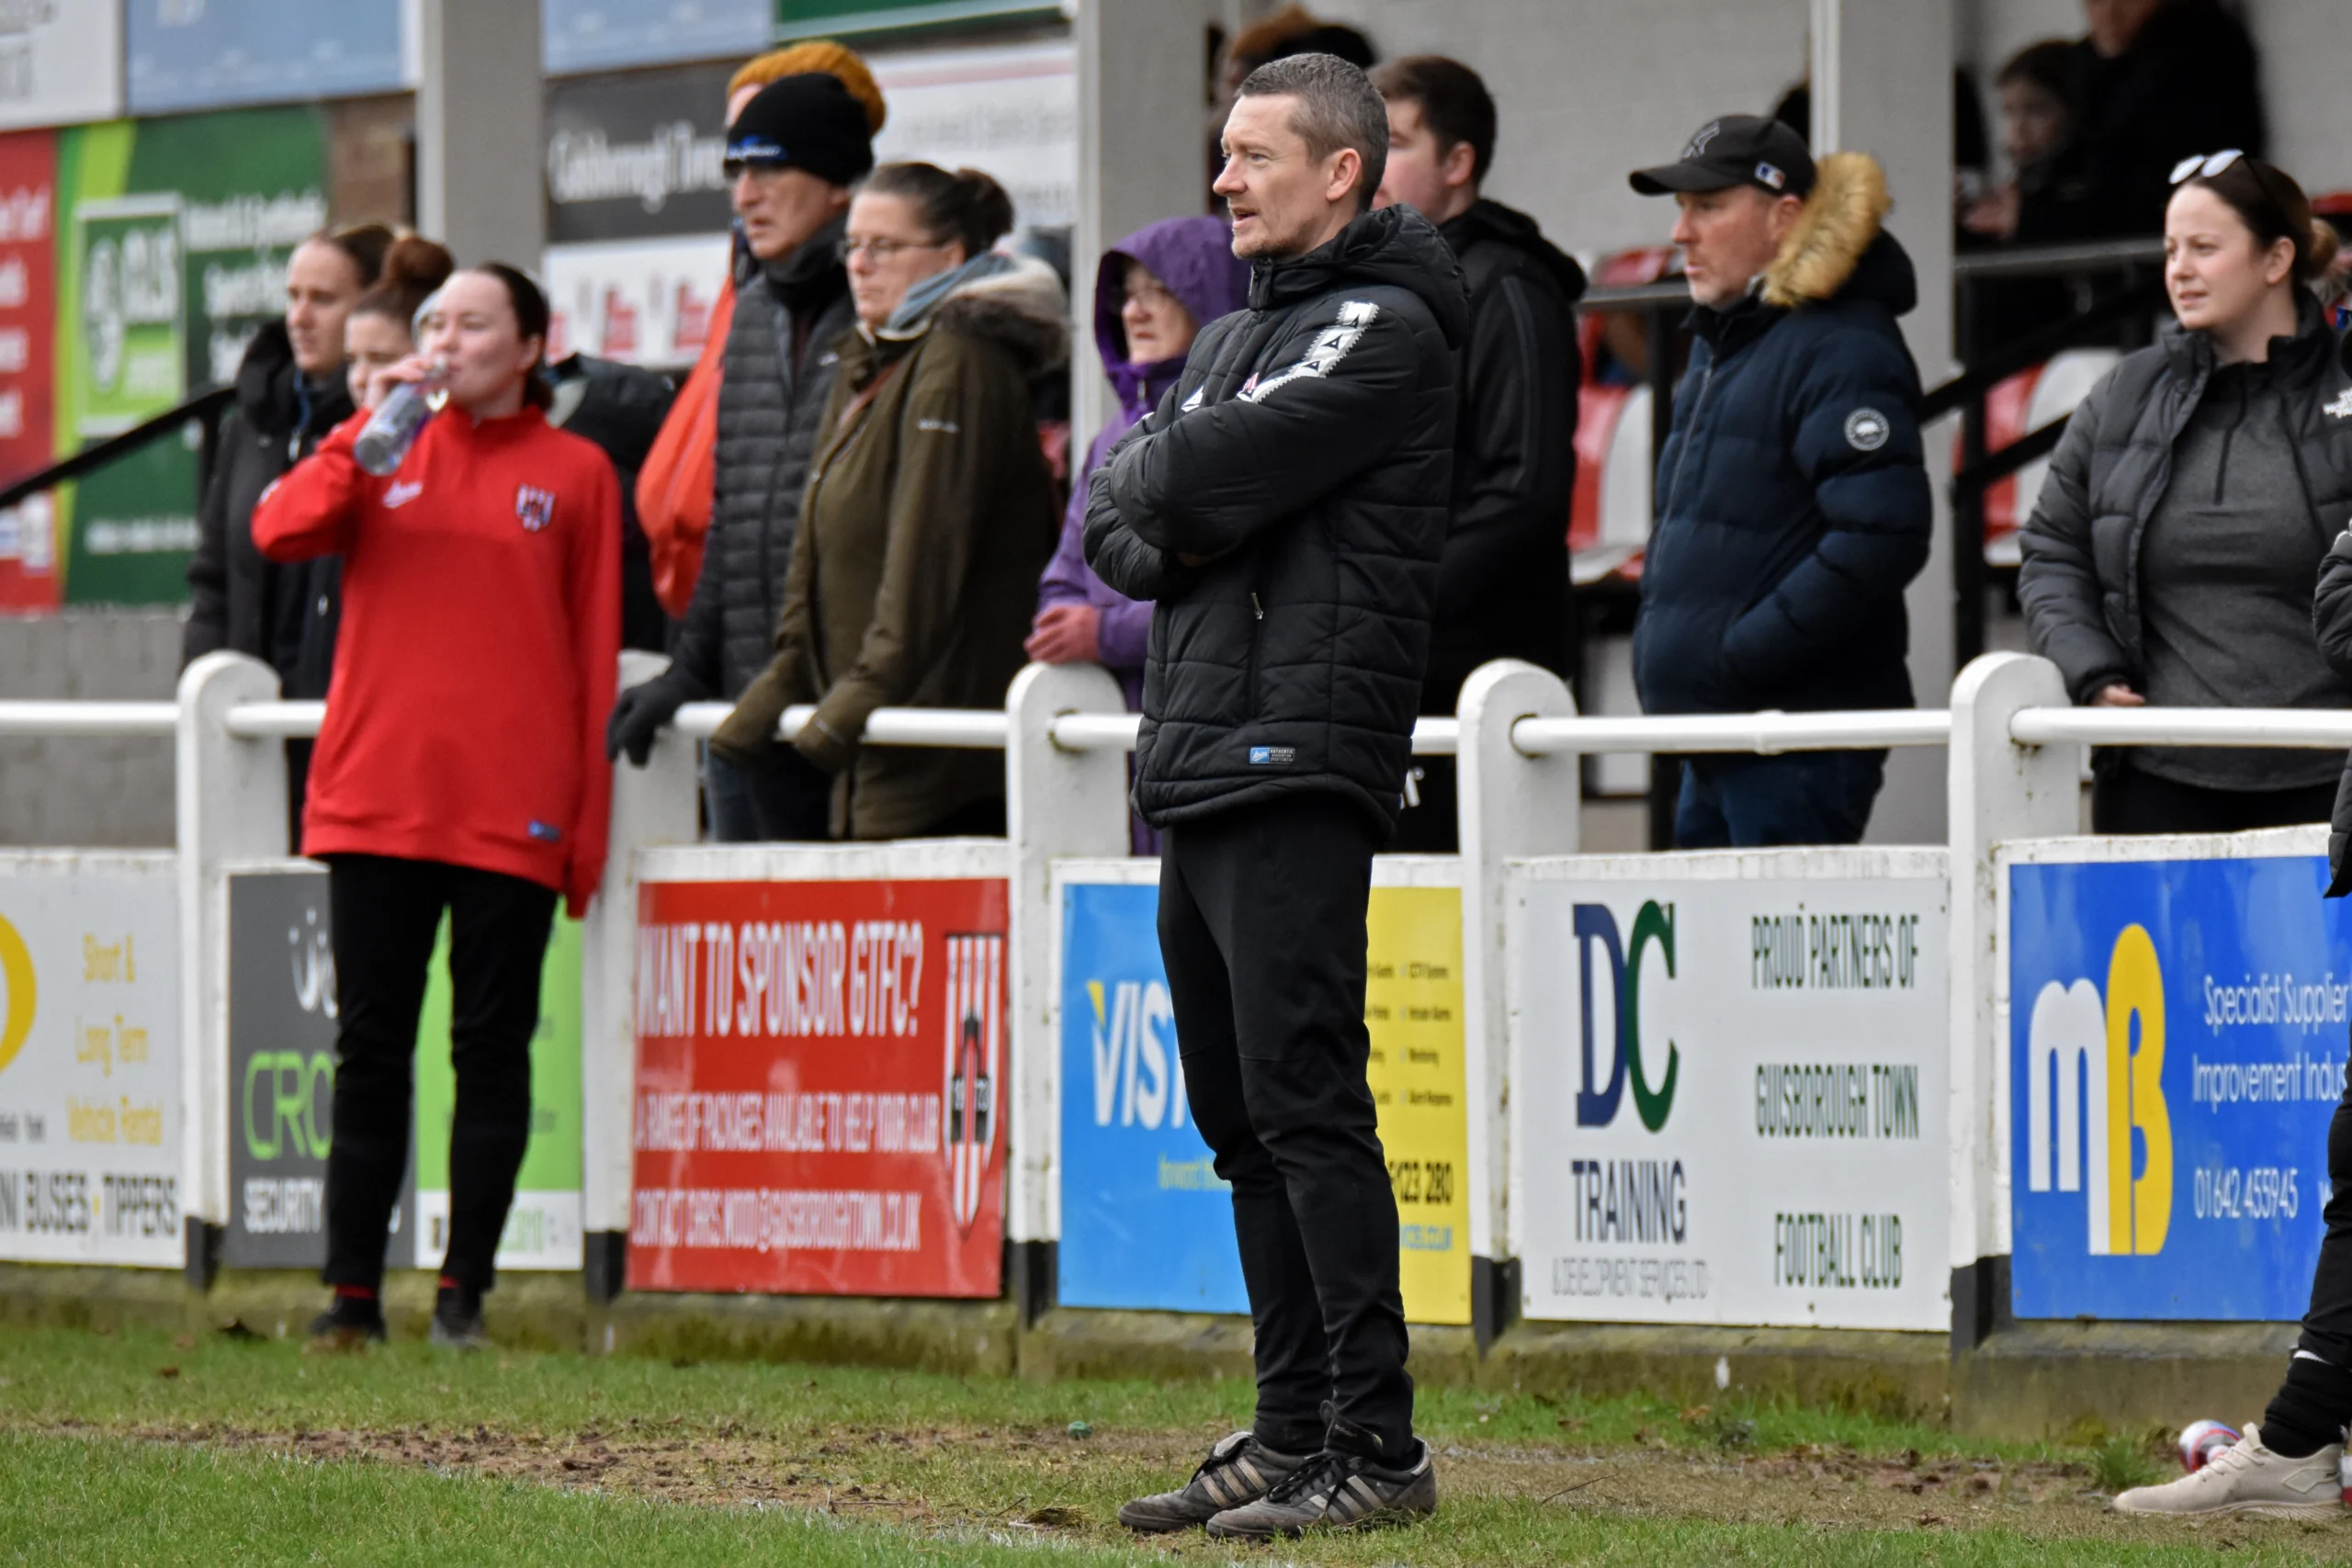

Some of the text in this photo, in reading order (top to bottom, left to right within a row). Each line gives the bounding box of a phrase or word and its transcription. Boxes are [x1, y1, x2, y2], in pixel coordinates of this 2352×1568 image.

[636, 920, 924, 1037] WANT TO SPONSOR GTFC?
[1751, 914, 1919, 989] PROUD PARTNERS OF
[1572, 899, 1680, 1134] DC
[2204, 972, 2352, 1037] Specialist Supplier
[243, 1051, 334, 1161] CRO
[1756, 1064, 1920, 1140] GUISBOROUGH TOWN
[2192, 1052, 2349, 1114] Improvement Indus
[26, 1172, 89, 1234] BUSES
[102, 1173, 177, 1237] TIPPERS
[243, 1178, 326, 1234] SECURITY
[1570, 1159, 1687, 1246] TRAINING
[2194, 1167, 2241, 1219] 01642
[2244, 1167, 2299, 1220] 455945
[1774, 1212, 1903, 1290] FOOTBALL CLUB
